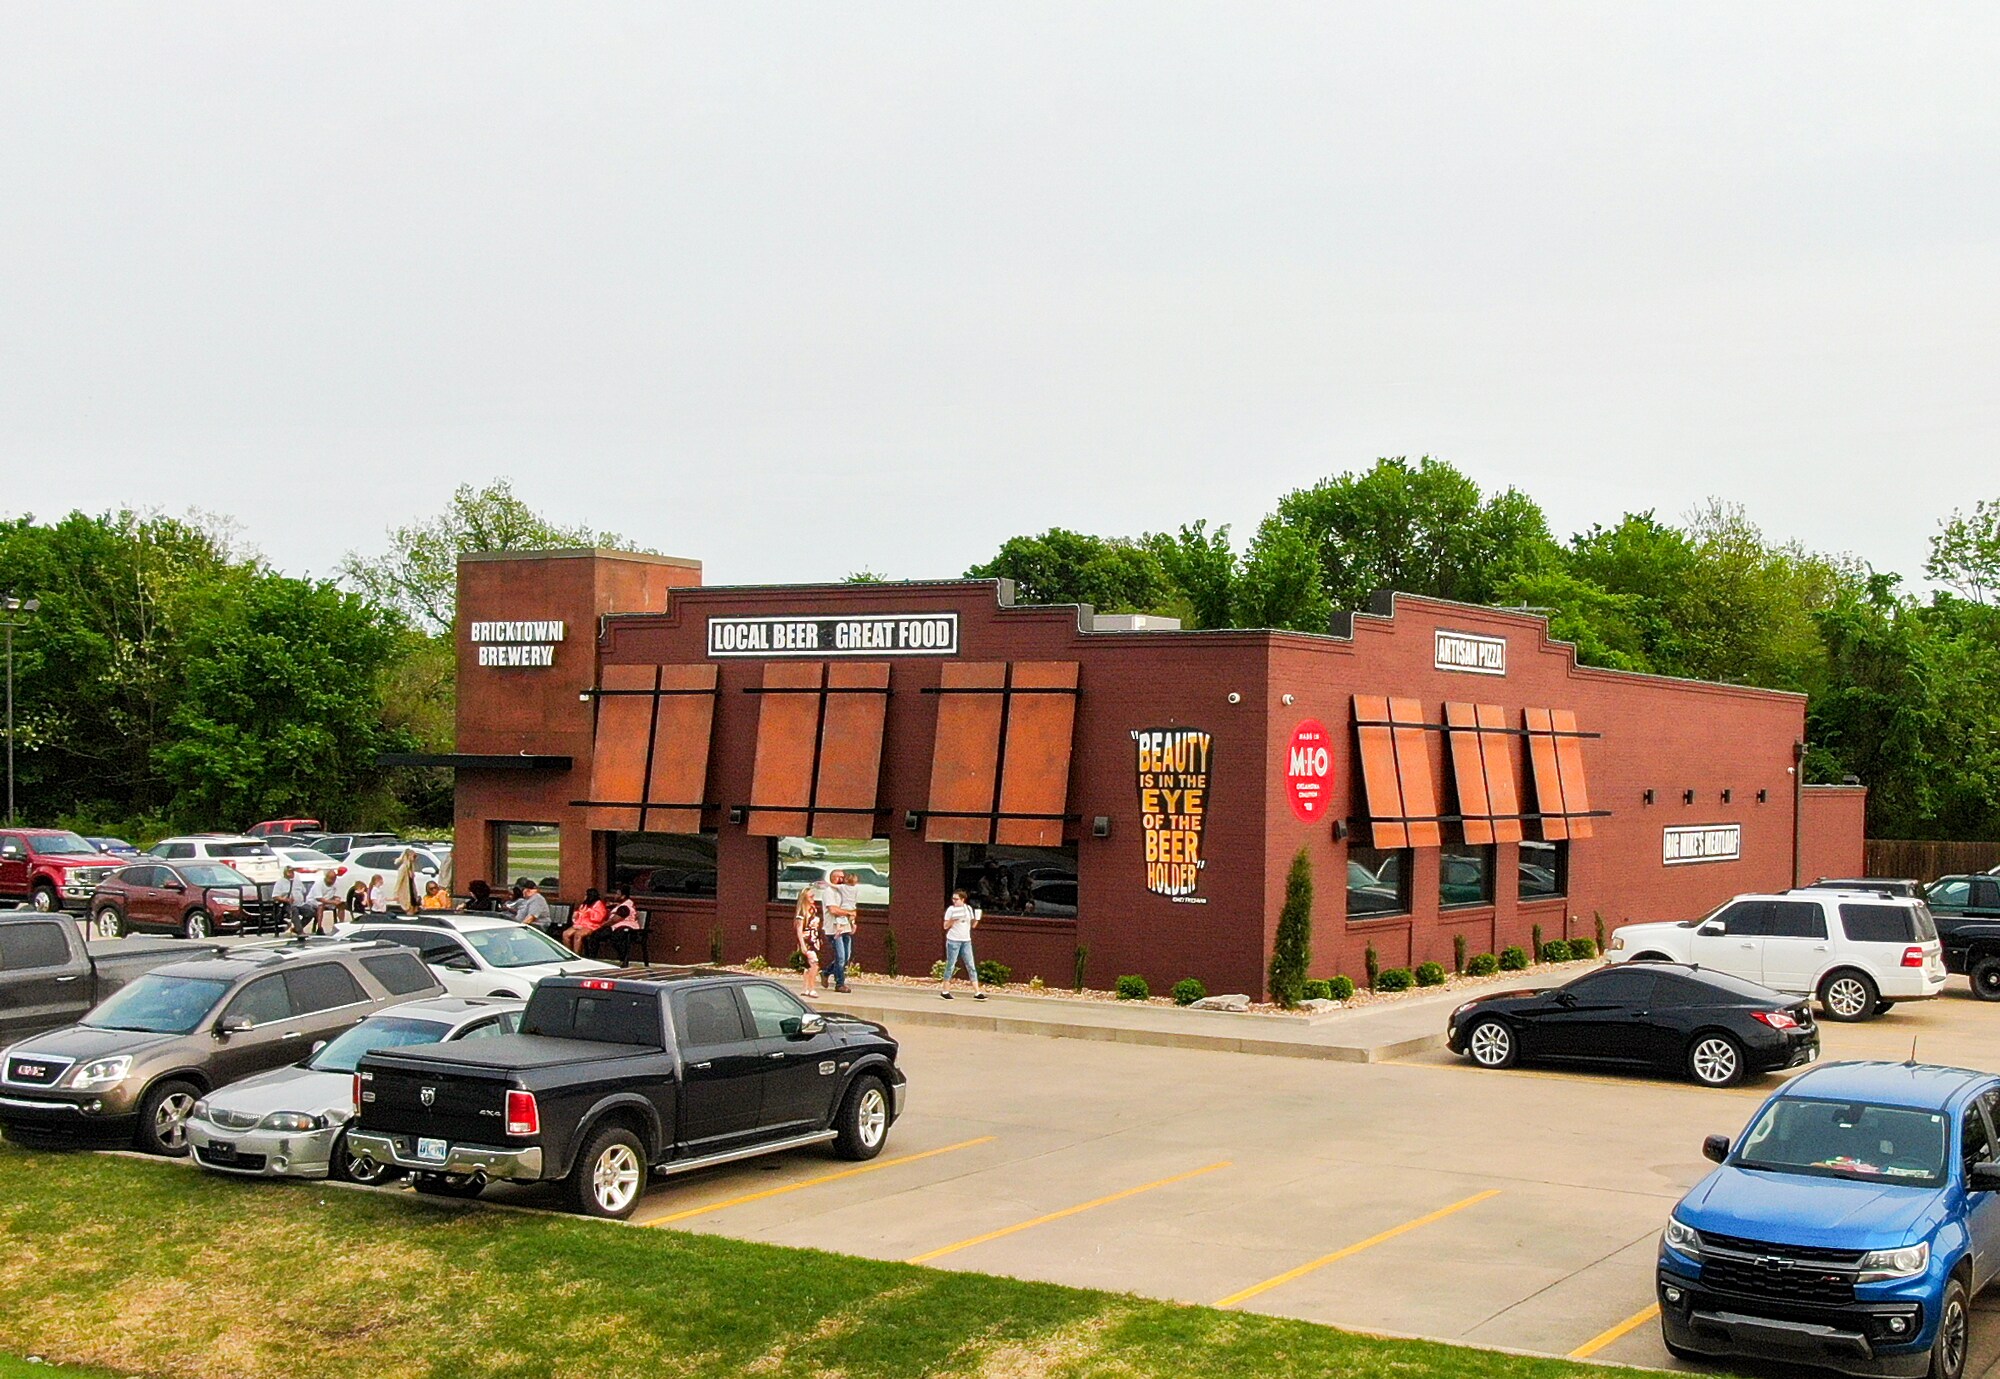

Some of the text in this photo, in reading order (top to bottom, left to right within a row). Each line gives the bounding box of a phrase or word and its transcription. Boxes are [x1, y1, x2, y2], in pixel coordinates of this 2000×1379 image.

[471, 621, 563, 641] BRICKTOWN
[715, 620, 949, 650] LOCAL BEER GREAT FOOD
[479, 646, 554, 666] BREWERY
[1438, 637, 1503, 669] ARTISAN PIZZA
[1140, 774, 1206, 788] IS IN THE
[1142, 788, 1202, 814] EYE
[1142, 814, 1201, 830] OF THE
[1145, 830, 1198, 863] BEER
[1665, 833, 1679, 858] BIG
[18, 1065, 46, 1077] GMC
